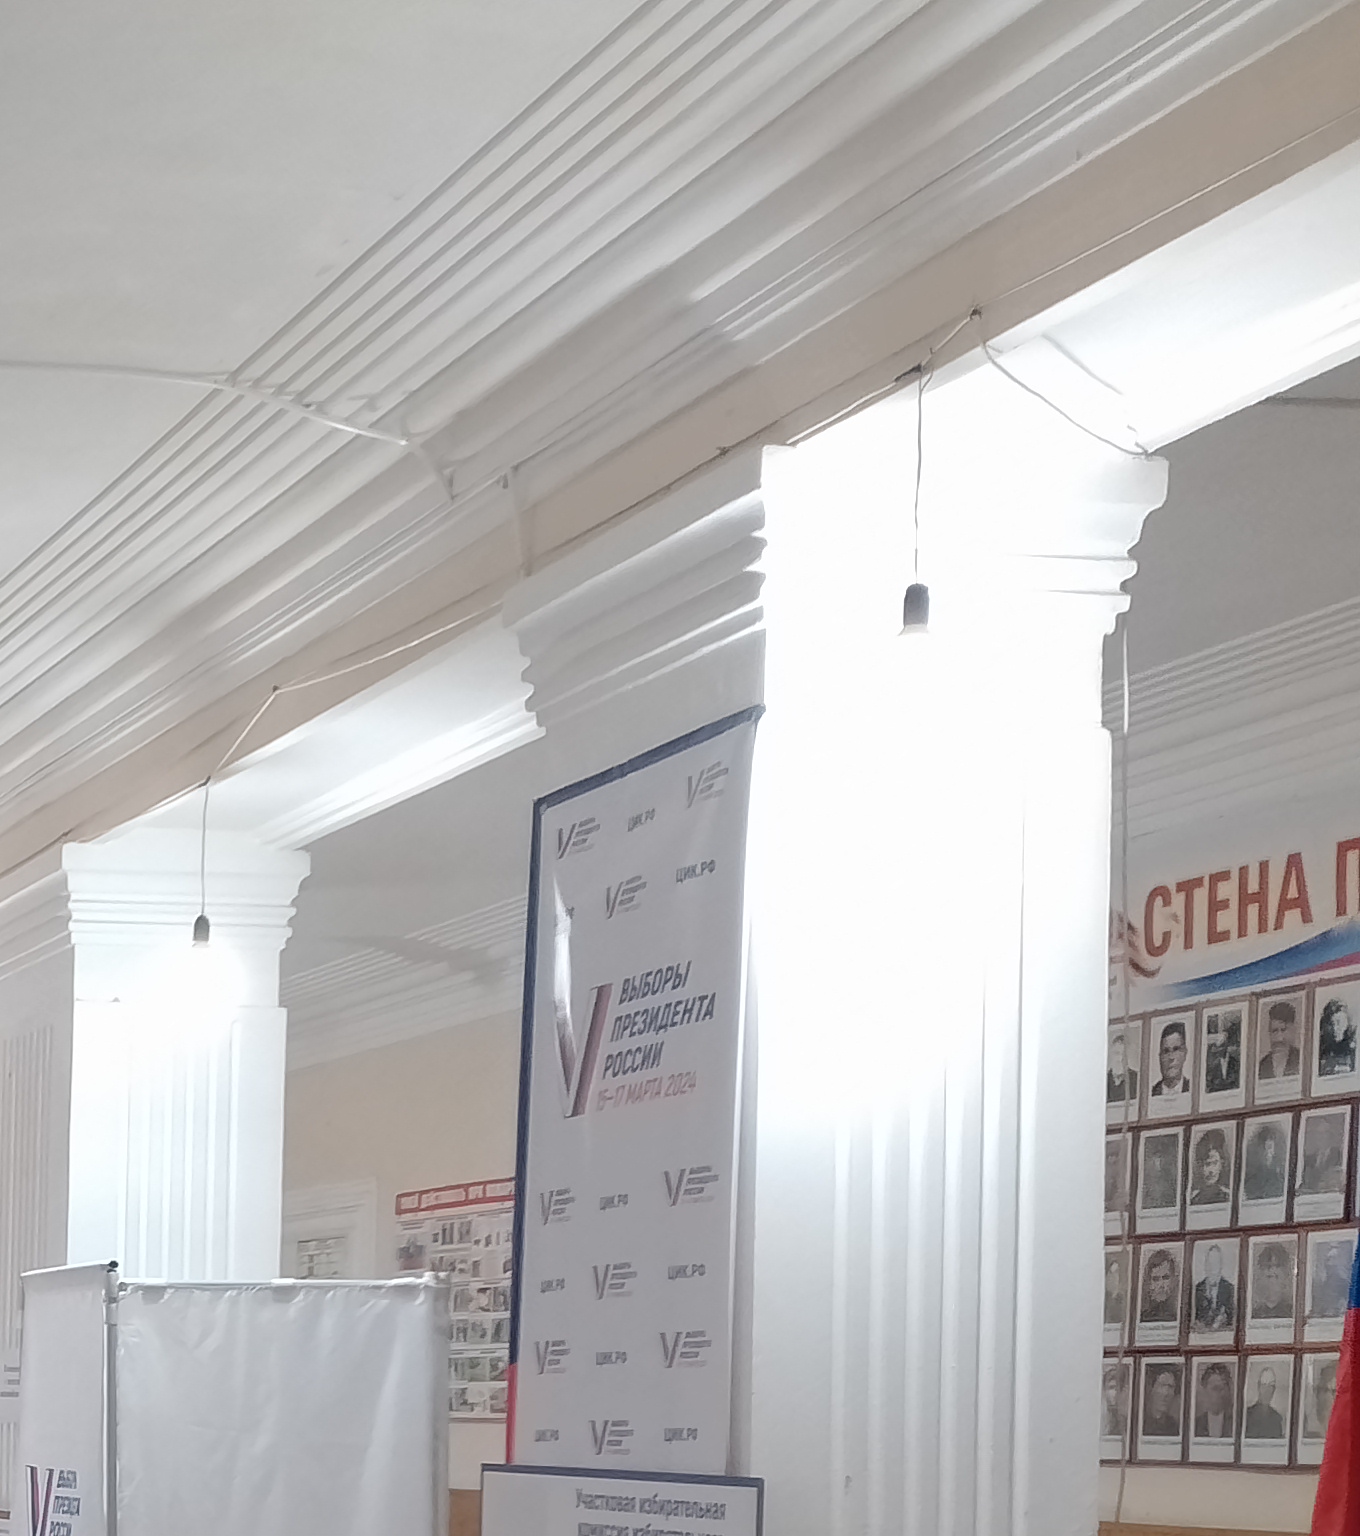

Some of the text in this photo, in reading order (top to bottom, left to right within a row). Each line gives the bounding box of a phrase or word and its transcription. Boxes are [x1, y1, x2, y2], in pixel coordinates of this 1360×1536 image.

[1143, 852, 1314, 957] СТЕНА
[618, 960, 692, 1005] ВЫБОРЫ
[610, 992, 717, 1042] ПРЕЗИДЕНТА
[602, 1040, 665, 1080] РОССИИ
